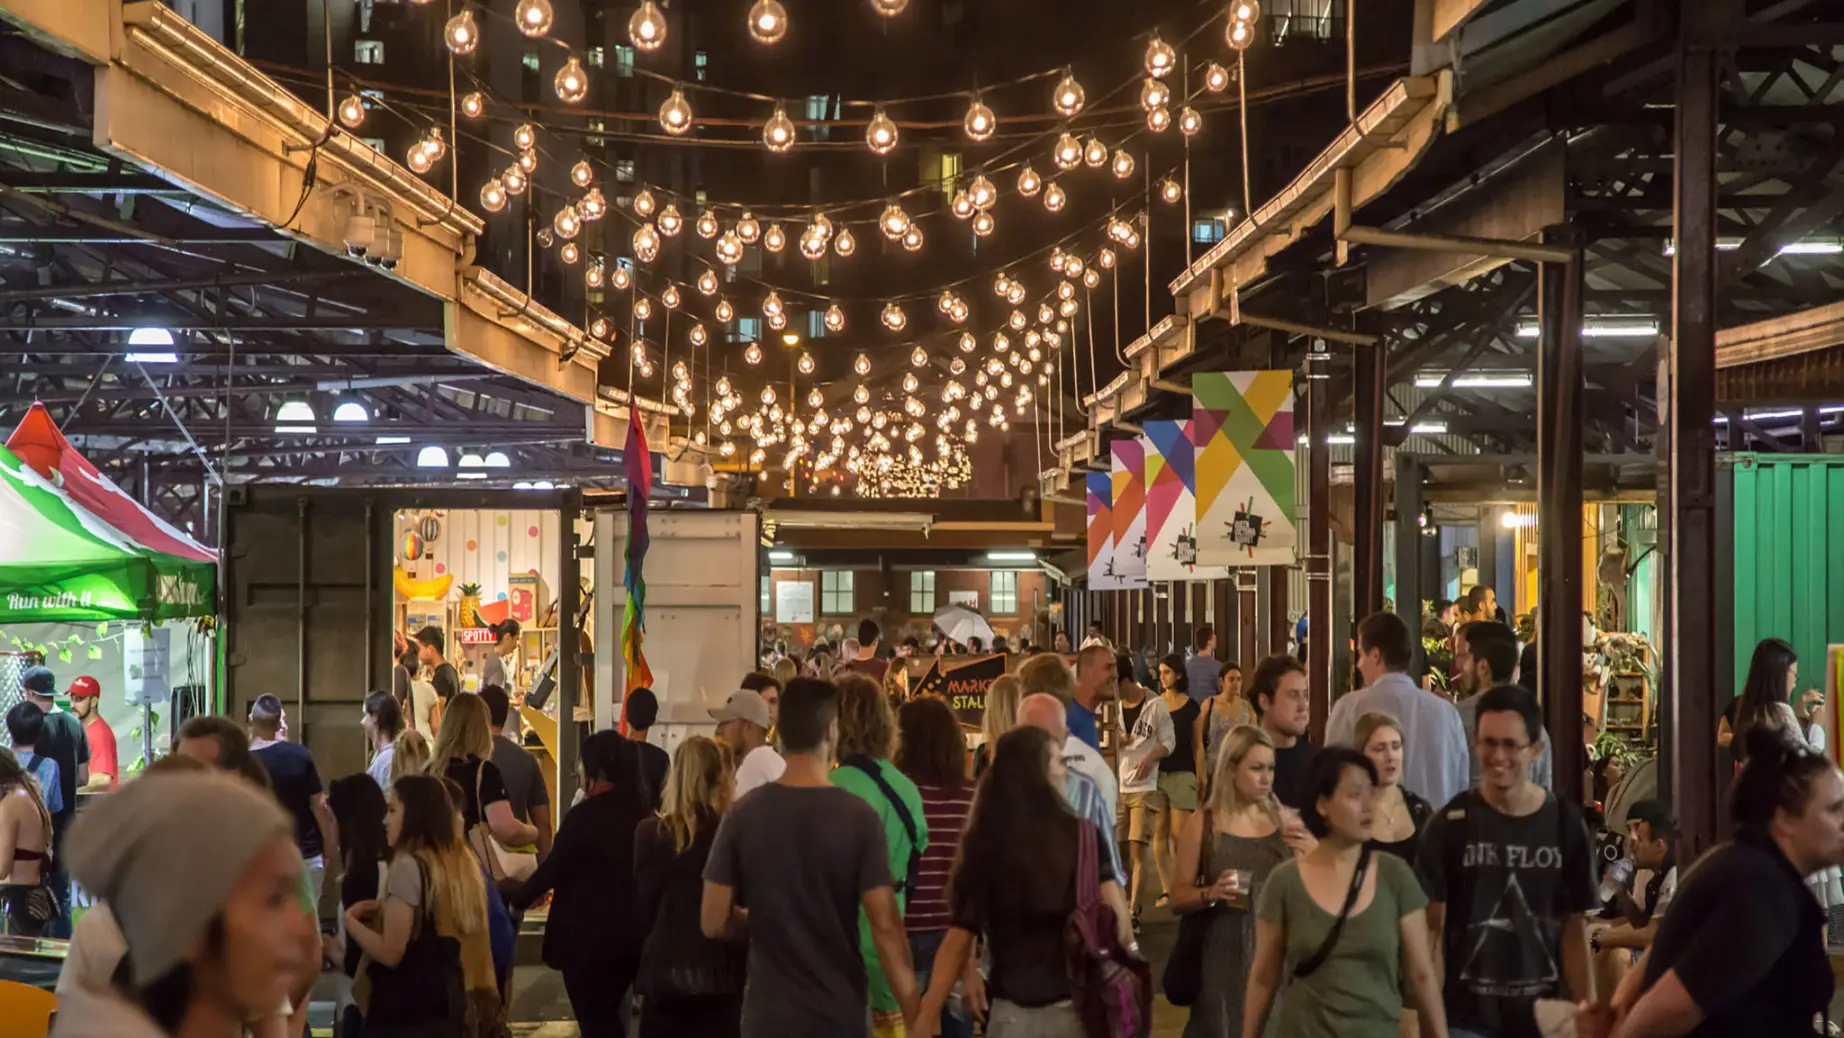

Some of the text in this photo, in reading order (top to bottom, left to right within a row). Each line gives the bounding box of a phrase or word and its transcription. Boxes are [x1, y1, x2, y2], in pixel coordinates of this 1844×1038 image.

[7, 591, 39, 610] Run
[42, 591, 77, 609] with
[463, 629, 493, 641] SPOTTY
